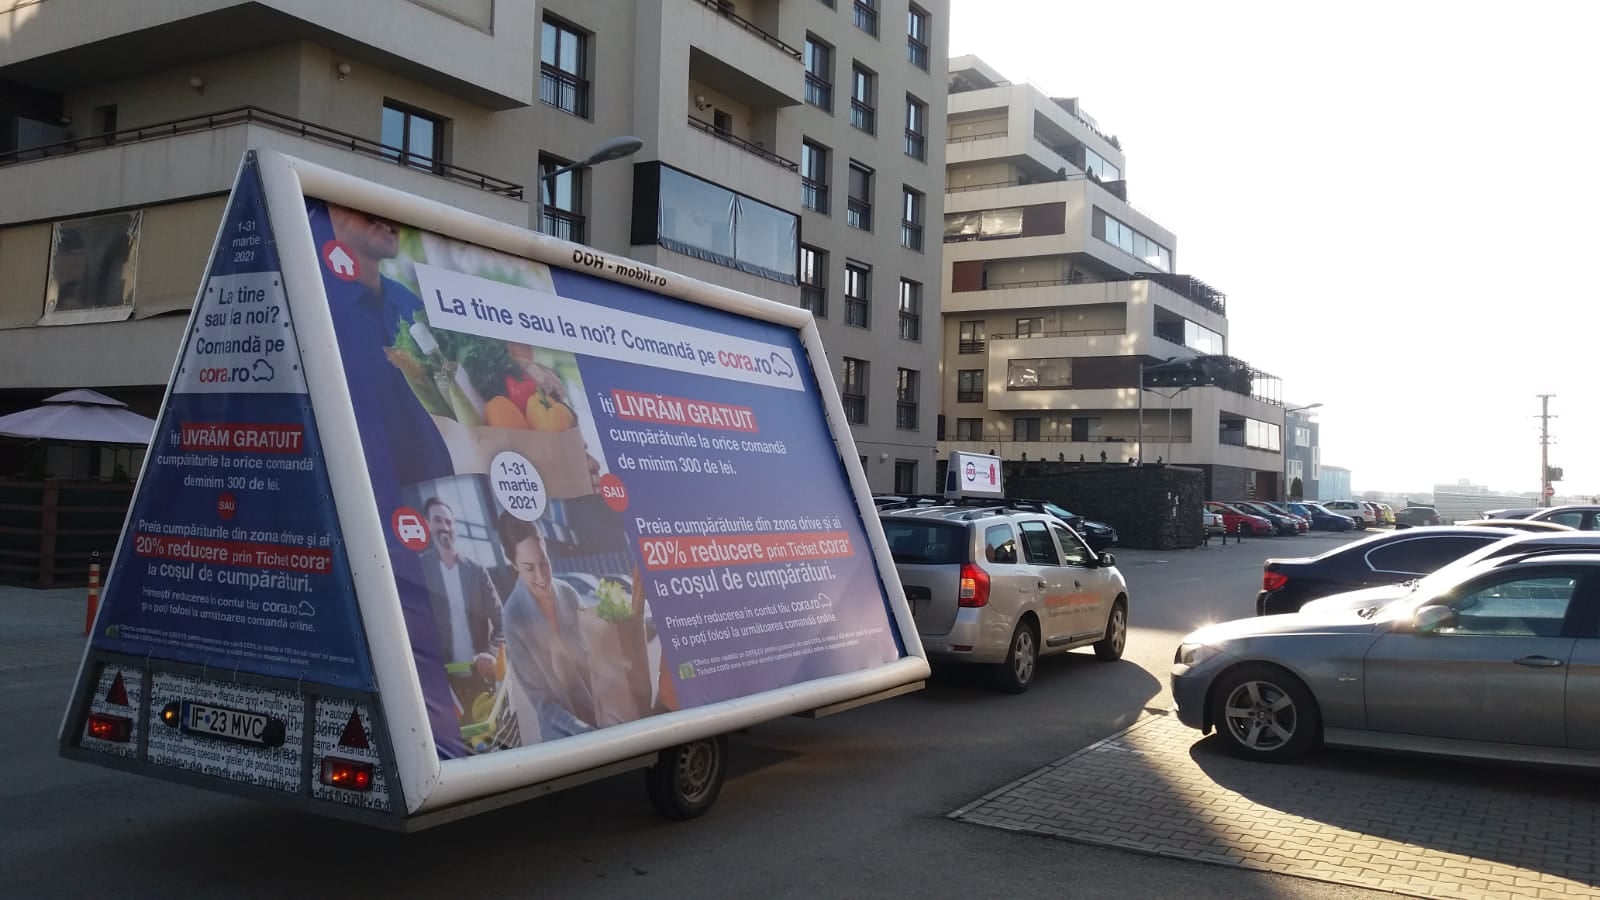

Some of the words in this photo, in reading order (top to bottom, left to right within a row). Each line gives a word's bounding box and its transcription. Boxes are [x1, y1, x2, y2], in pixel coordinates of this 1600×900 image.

[233, 235, 260, 247] martie
[234, 250, 254, 262] 2021
[219, 288, 233, 305] La
[237, 286, 265, 303] tine
[205, 313, 227, 327] sau
[231, 308, 241, 325] la
[246, 305, 280, 324] noi?
[436, 289, 467, 317] La
[471, 298, 513, 326] tine
[518, 313, 555, 334] sau
[558, 315, 577, 338] la
[581, 325, 617, 346] noi?
[621, 329, 695, 361] Comandă
[699, 349, 716, 367] pe
[718, 350, 772, 375] cora.ro
[196, 335, 262, 355] Comandă
[265, 338, 285, 357] pe
[199, 366, 250, 383] cora.ro
[615, 393, 686, 422] LIVRĂM
[687, 403, 753, 429] GRATUIT
[183, 425, 229, 447] LIVRĂM
[234, 430, 301, 448] GRATUIT
[610, 428, 697, 448] cumpărăturile
[698, 433, 710, 449] la
[712, 435, 740, 451] orice
[741, 440, 787, 454] comandă
[221, 455, 230, 468] la
[233, 455, 263, 468] orice
[266, 457, 313, 471] comandă
[500, 461, 527, 476] 1-31
[618, 453, 635, 470] de
[638, 454, 678, 472] minim
[680, 457, 701, 473] 300
[703, 459, 718, 474] de
[720, 460, 737, 475] lei.
[227, 476, 245, 490] 300
[249, 477, 264, 490] de
[498, 478, 538, 492] martie
[603, 486, 625, 498] SAU
[219, 501, 235, 511] SAU
[508, 495, 537, 510] 2021
[139, 519, 161, 533] Preia
[232, 528, 247, 540] din
[250, 531, 278, 543] zona
[320, 533, 330, 546] ai
[635, 517, 671, 535] Preia
[675, 516, 753, 537] cumpărăturile
[755, 516, 772, 532] din
[773, 519, 797, 531] zona
[798, 516, 821, 530] drive
[833, 517, 842, 529] ai
[136, 536, 164, 555] 20%
[167, 540, 228, 561] reducere
[232, 550, 252, 565] prin
[256, 551, 289, 567] Tichet
[643, 539, 688, 566] 20%
[691, 540, 763, 563] reducere
[766, 544, 786, 561] prin
[786, 541, 819, 557] Tichet
[148, 562, 156, 576] la
[198, 564, 213, 582] de
[654, 579, 669, 598] la
[671, 571, 719, 599] coșul
[721, 567, 744, 591] de
[746, 560, 836, 591] cumpărături.
[703, 608, 745, 624] reducerea
[681, 636, 689, 647] o
[731, 626, 740, 638] la
[191, 706, 206, 728] IF
[210, 710, 227, 733] 23
[231, 713, 263, 739] MVC
